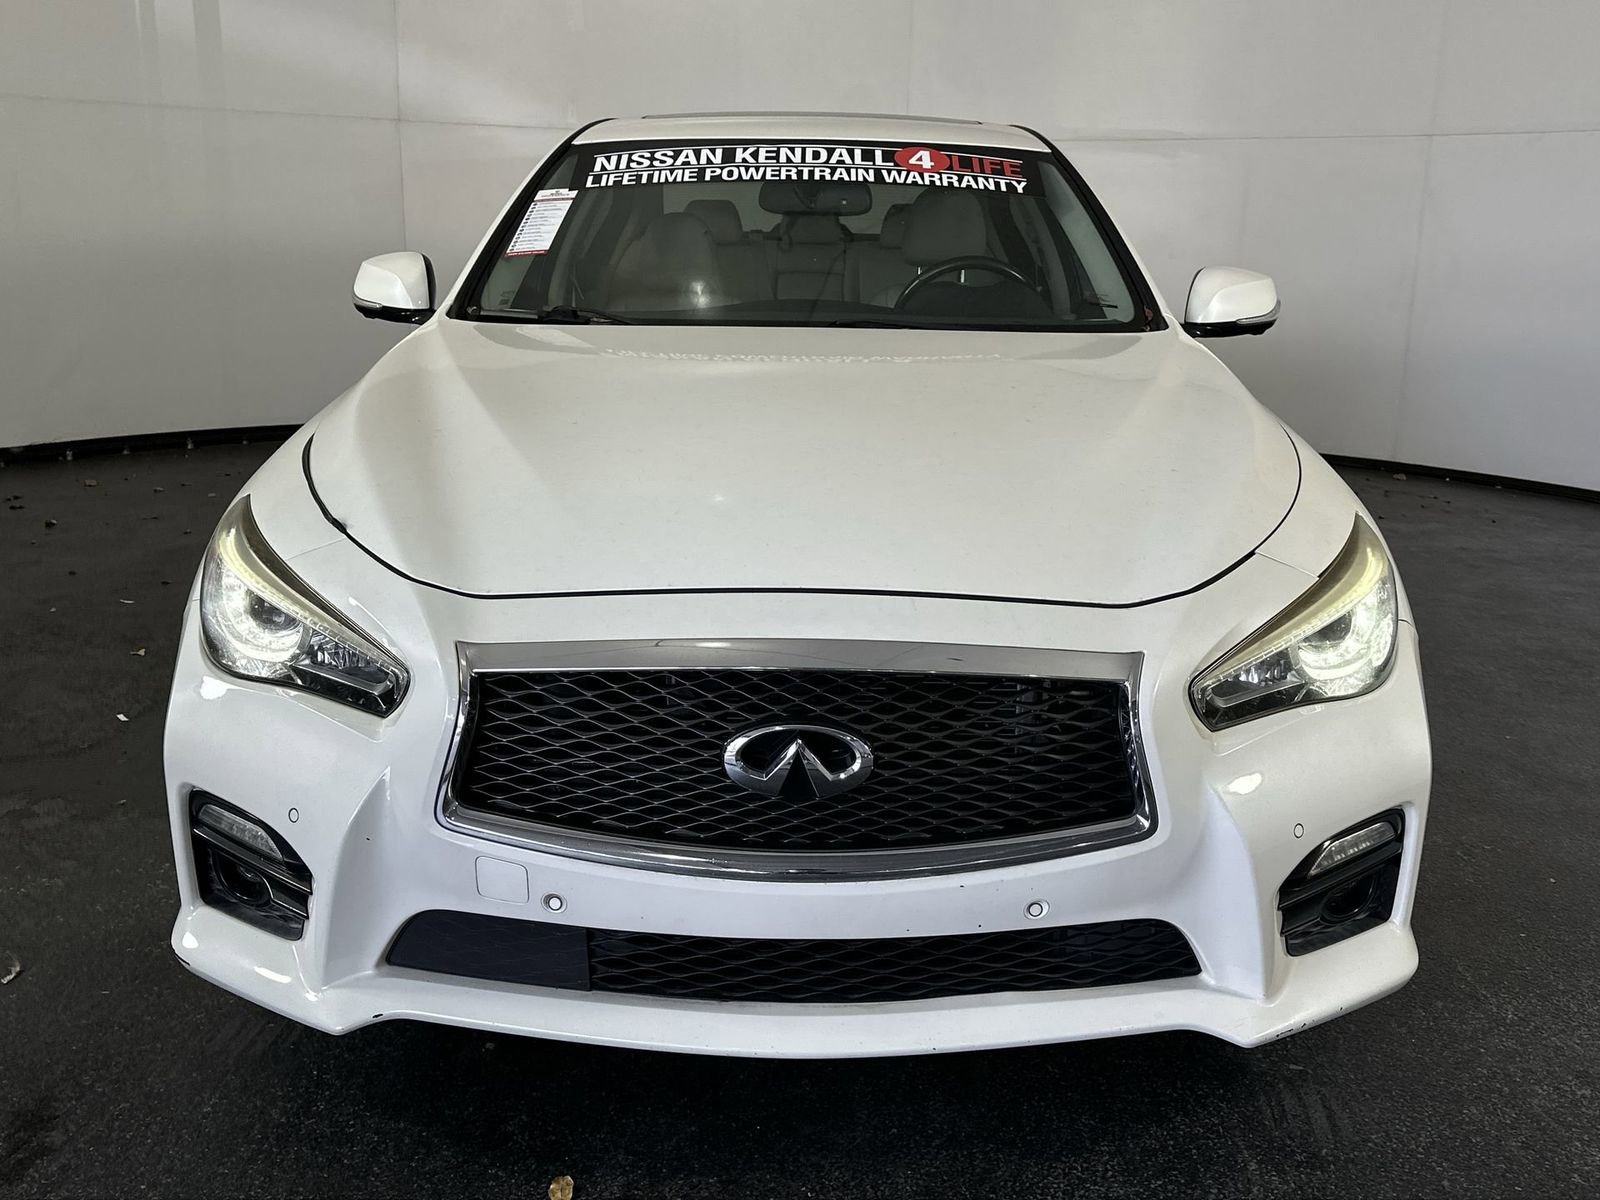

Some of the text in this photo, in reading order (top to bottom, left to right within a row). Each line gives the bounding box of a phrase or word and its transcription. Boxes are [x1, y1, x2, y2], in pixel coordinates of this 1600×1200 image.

[593, 147, 1023, 177] NISSAN KENDALL 4 LIFE
[585, 166, 1027, 194] LIFETIME POWERTRAIN WARRANTY
